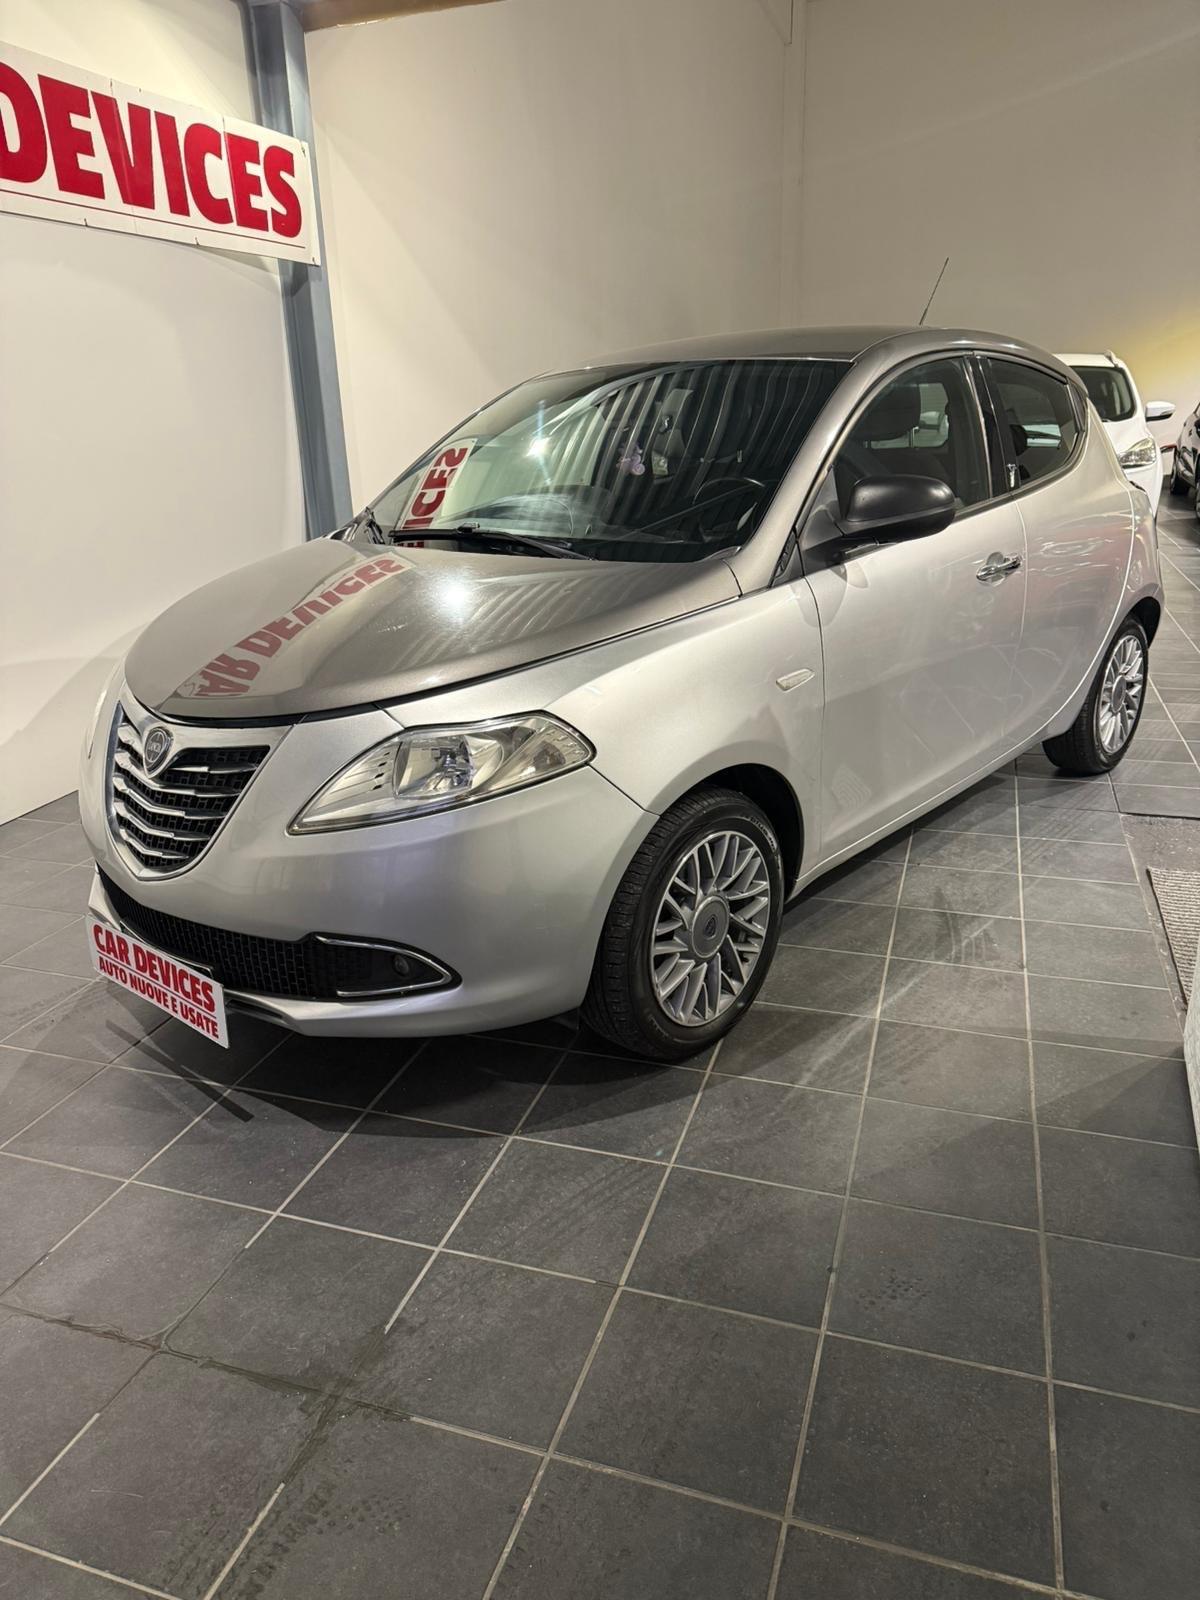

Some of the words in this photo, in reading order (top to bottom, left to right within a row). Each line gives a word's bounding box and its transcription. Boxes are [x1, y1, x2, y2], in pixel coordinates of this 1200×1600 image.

[0, 61, 303, 238] DEVICES
[93, 924, 131, 966] CAR
[132, 943, 215, 1013] DEVICES
[99, 956, 128, 984] AUTO
[129, 973, 169, 1009] NUOVE
[171, 995, 179, 1014] E
[180, 1001, 219, 1039] USATE
